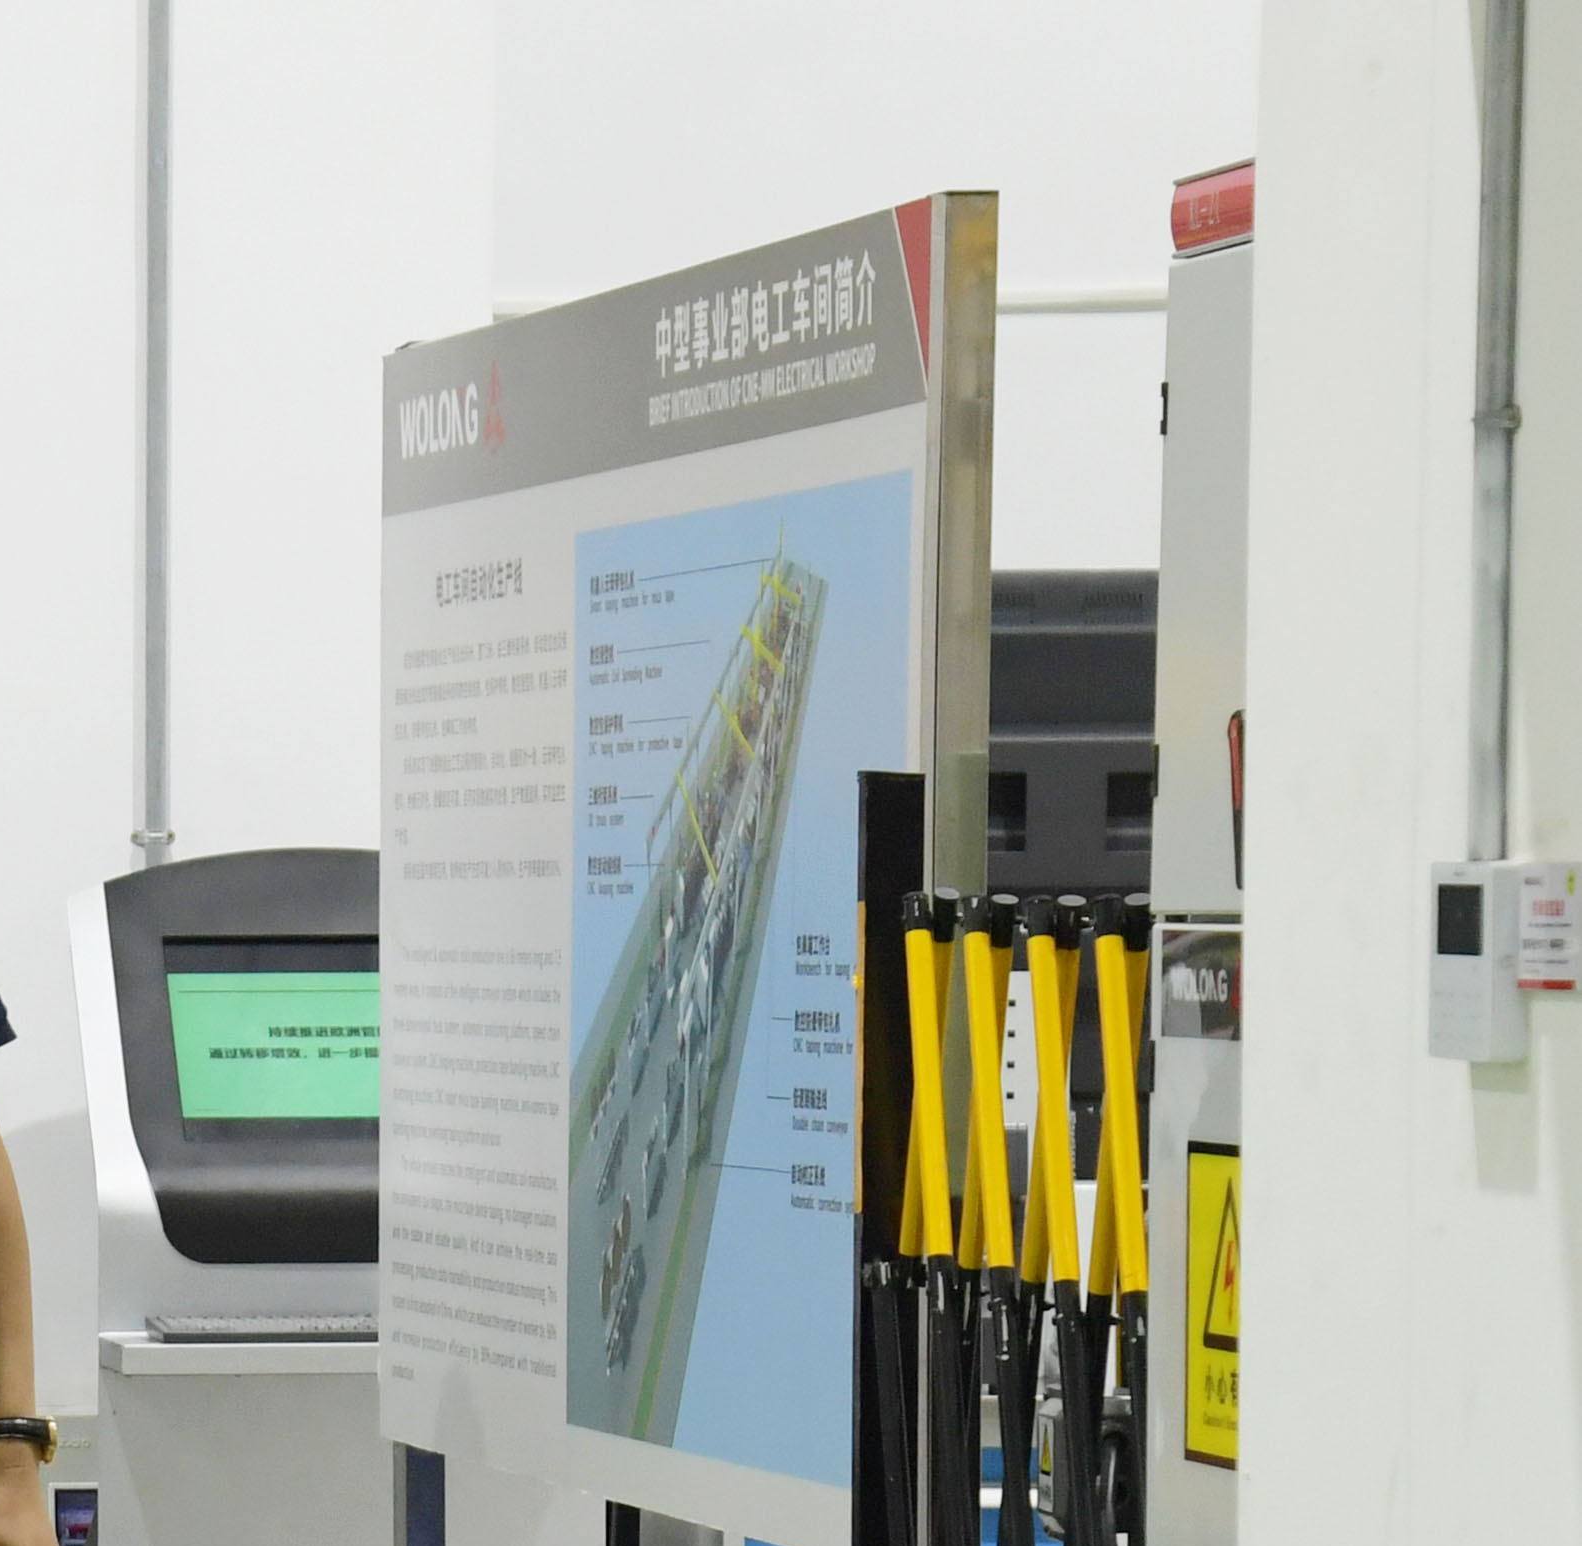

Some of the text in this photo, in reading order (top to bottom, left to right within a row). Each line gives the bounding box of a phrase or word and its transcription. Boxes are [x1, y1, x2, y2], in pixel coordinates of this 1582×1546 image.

[655, 249, 877, 379] 中型事业部电工车间简介
[399, 382, 479, 460] WOLONG
[649, 391, 671, 428] BRIEF
[671, 379, 730, 421] INTRODUCTION
[730, 375, 741, 408] OF
[776, 355, 825, 397] ELECTRICAL
[825, 342, 877, 388] WORKSHOP
